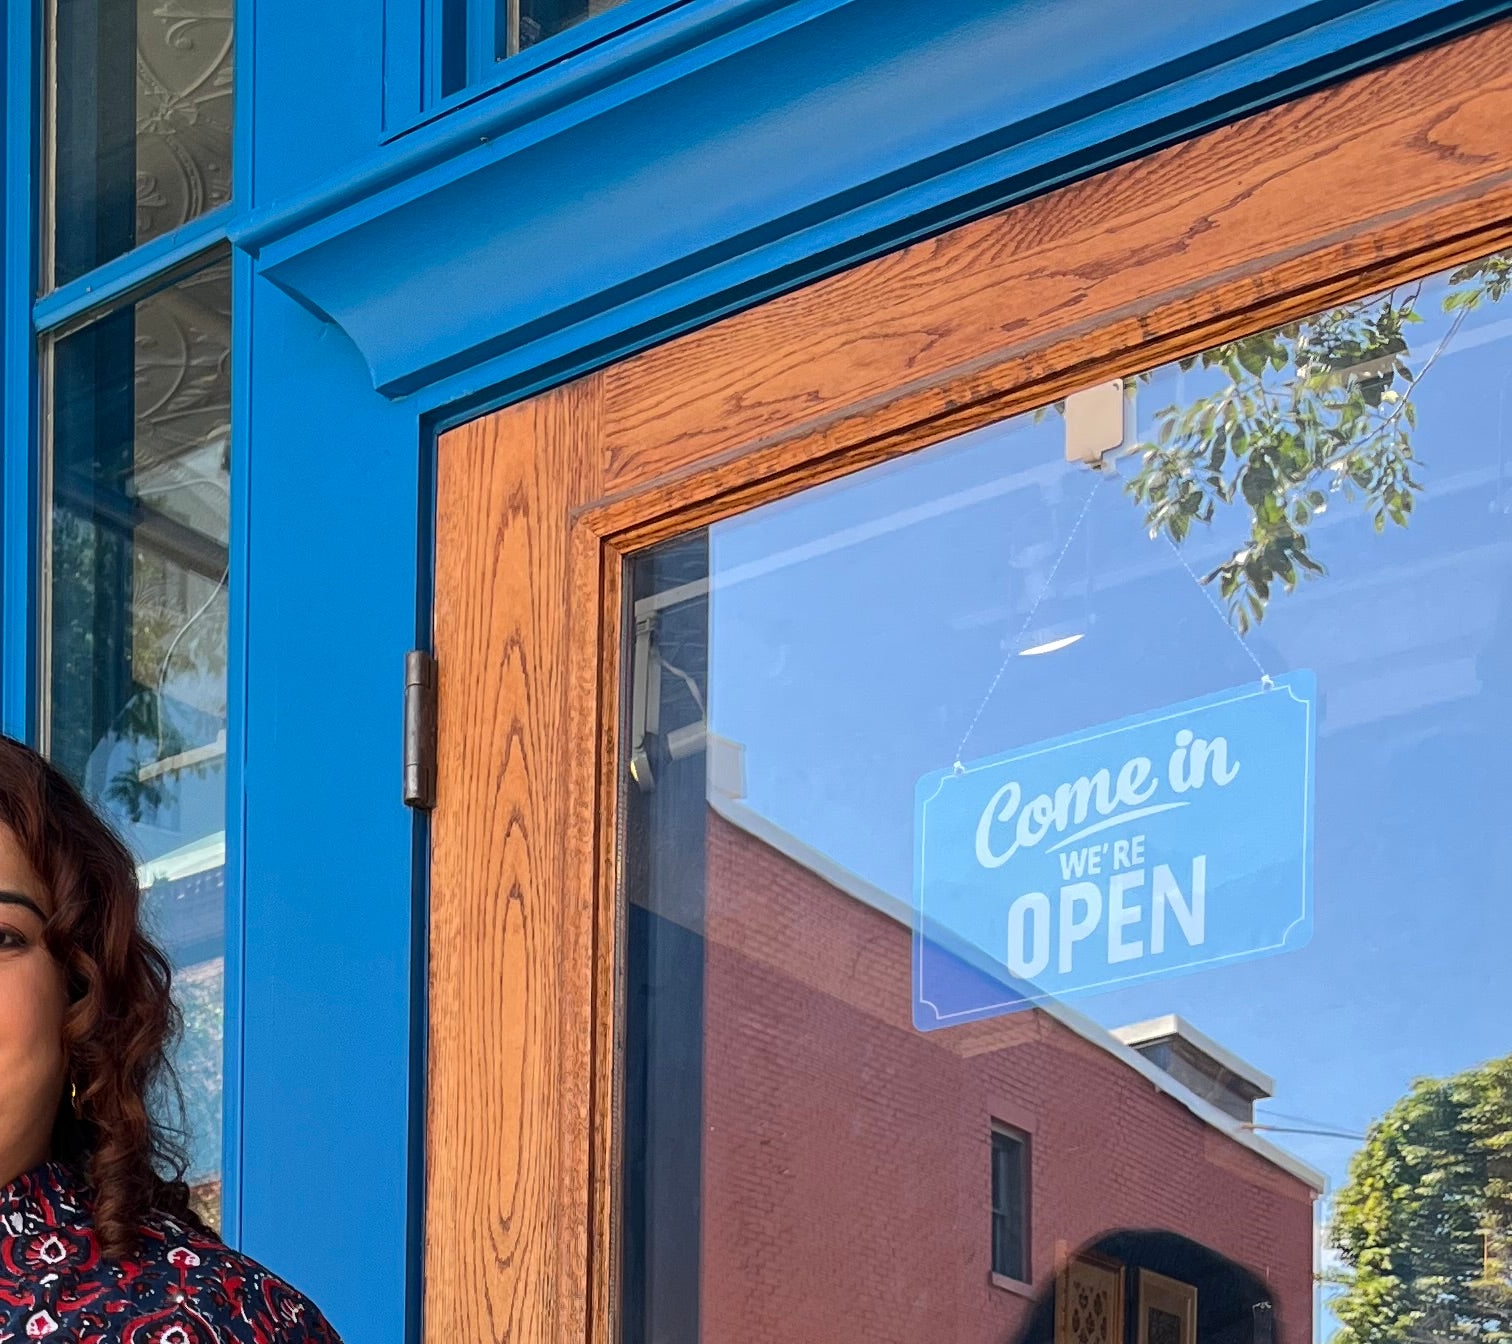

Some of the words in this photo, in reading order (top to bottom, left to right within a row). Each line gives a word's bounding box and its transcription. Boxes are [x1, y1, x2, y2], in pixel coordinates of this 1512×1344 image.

[975, 757, 1158, 868] Come
[1168, 729, 1240, 793] in
[1059, 835, 1145, 880] WE'RE
[1007, 854, 1206, 979] OPEN
